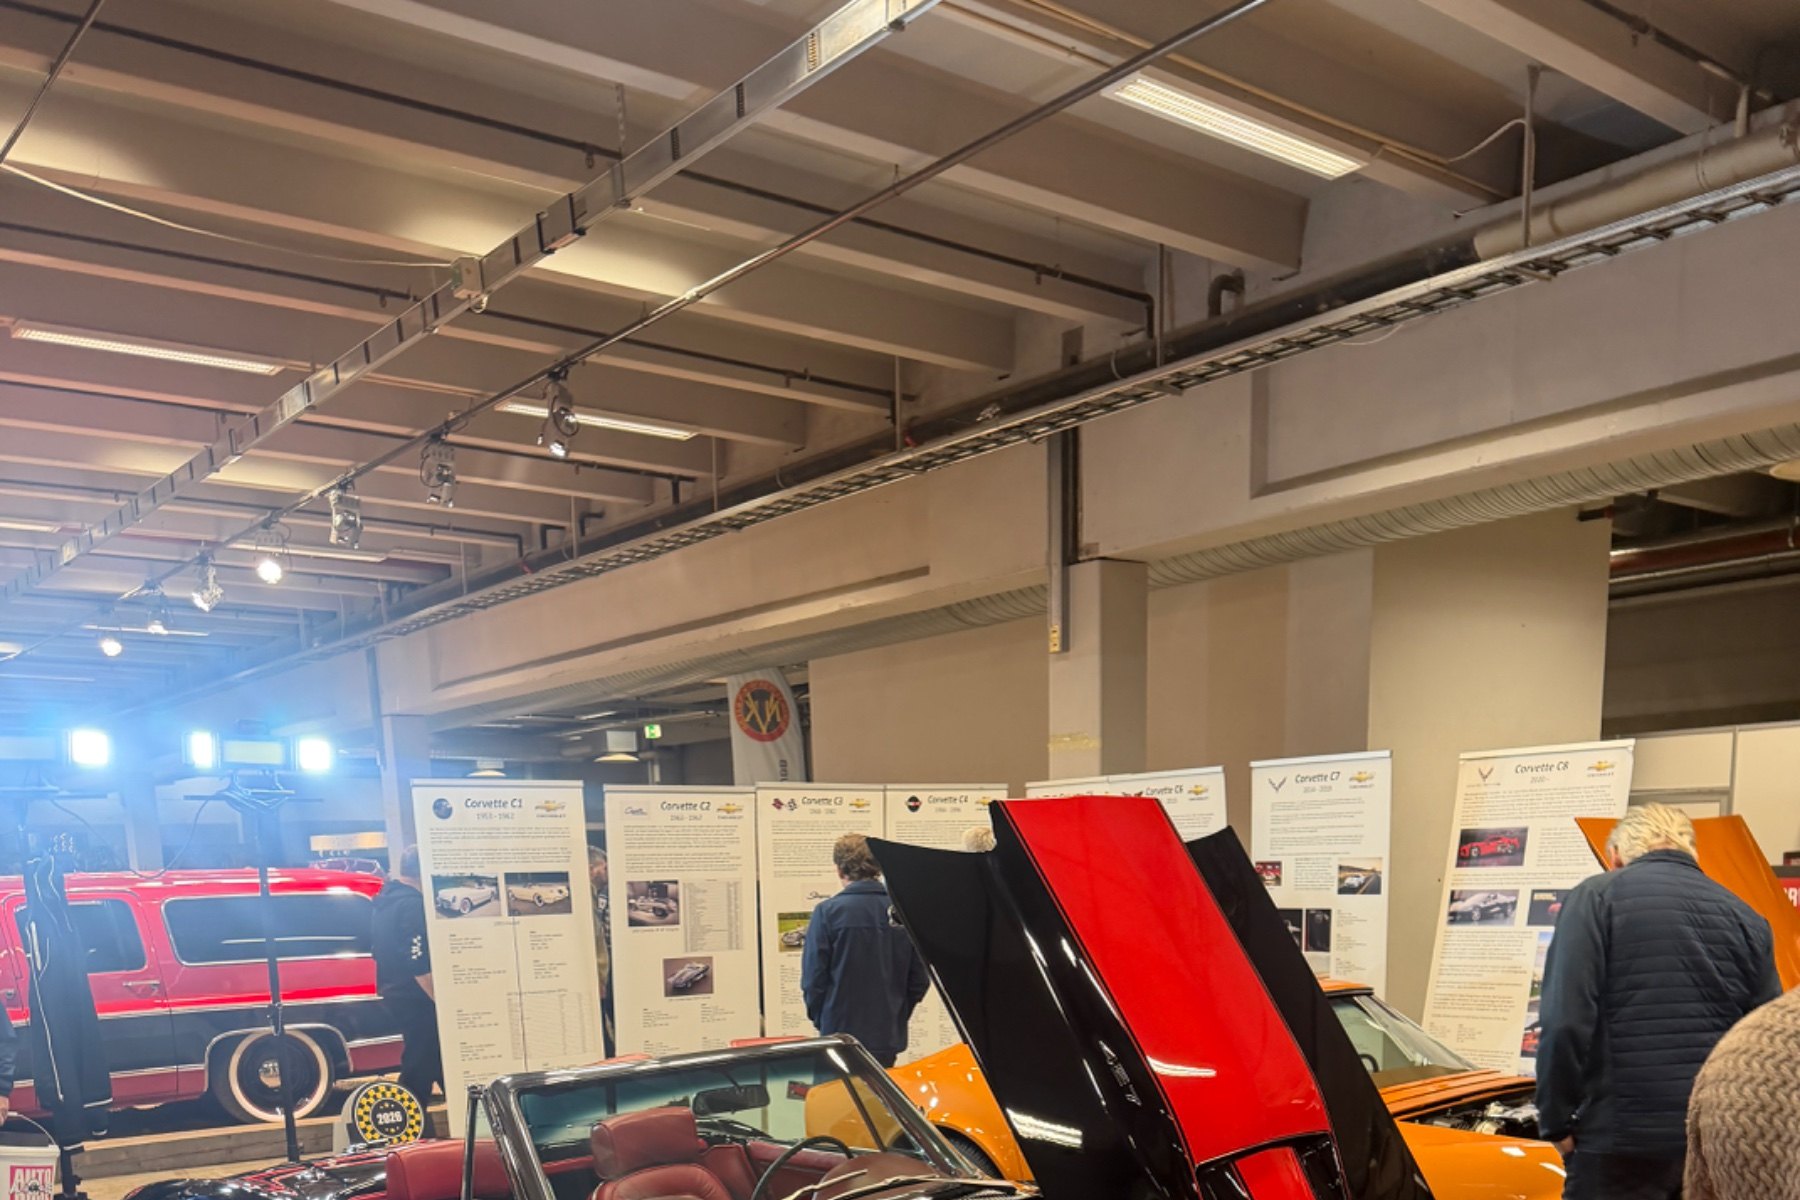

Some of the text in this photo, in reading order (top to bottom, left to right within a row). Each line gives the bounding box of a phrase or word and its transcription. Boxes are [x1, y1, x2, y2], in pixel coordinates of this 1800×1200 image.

[1514, 762, 1555, 775] Corvette
[1294, 771, 1341, 784] Corvette C7
[464, 798, 523, 809] Corvette C1
[927, 795, 957, 804] Corvette
[660, 801, 711, 811] Corvette C2
[12, 1168, 52, 1192] AUTO
